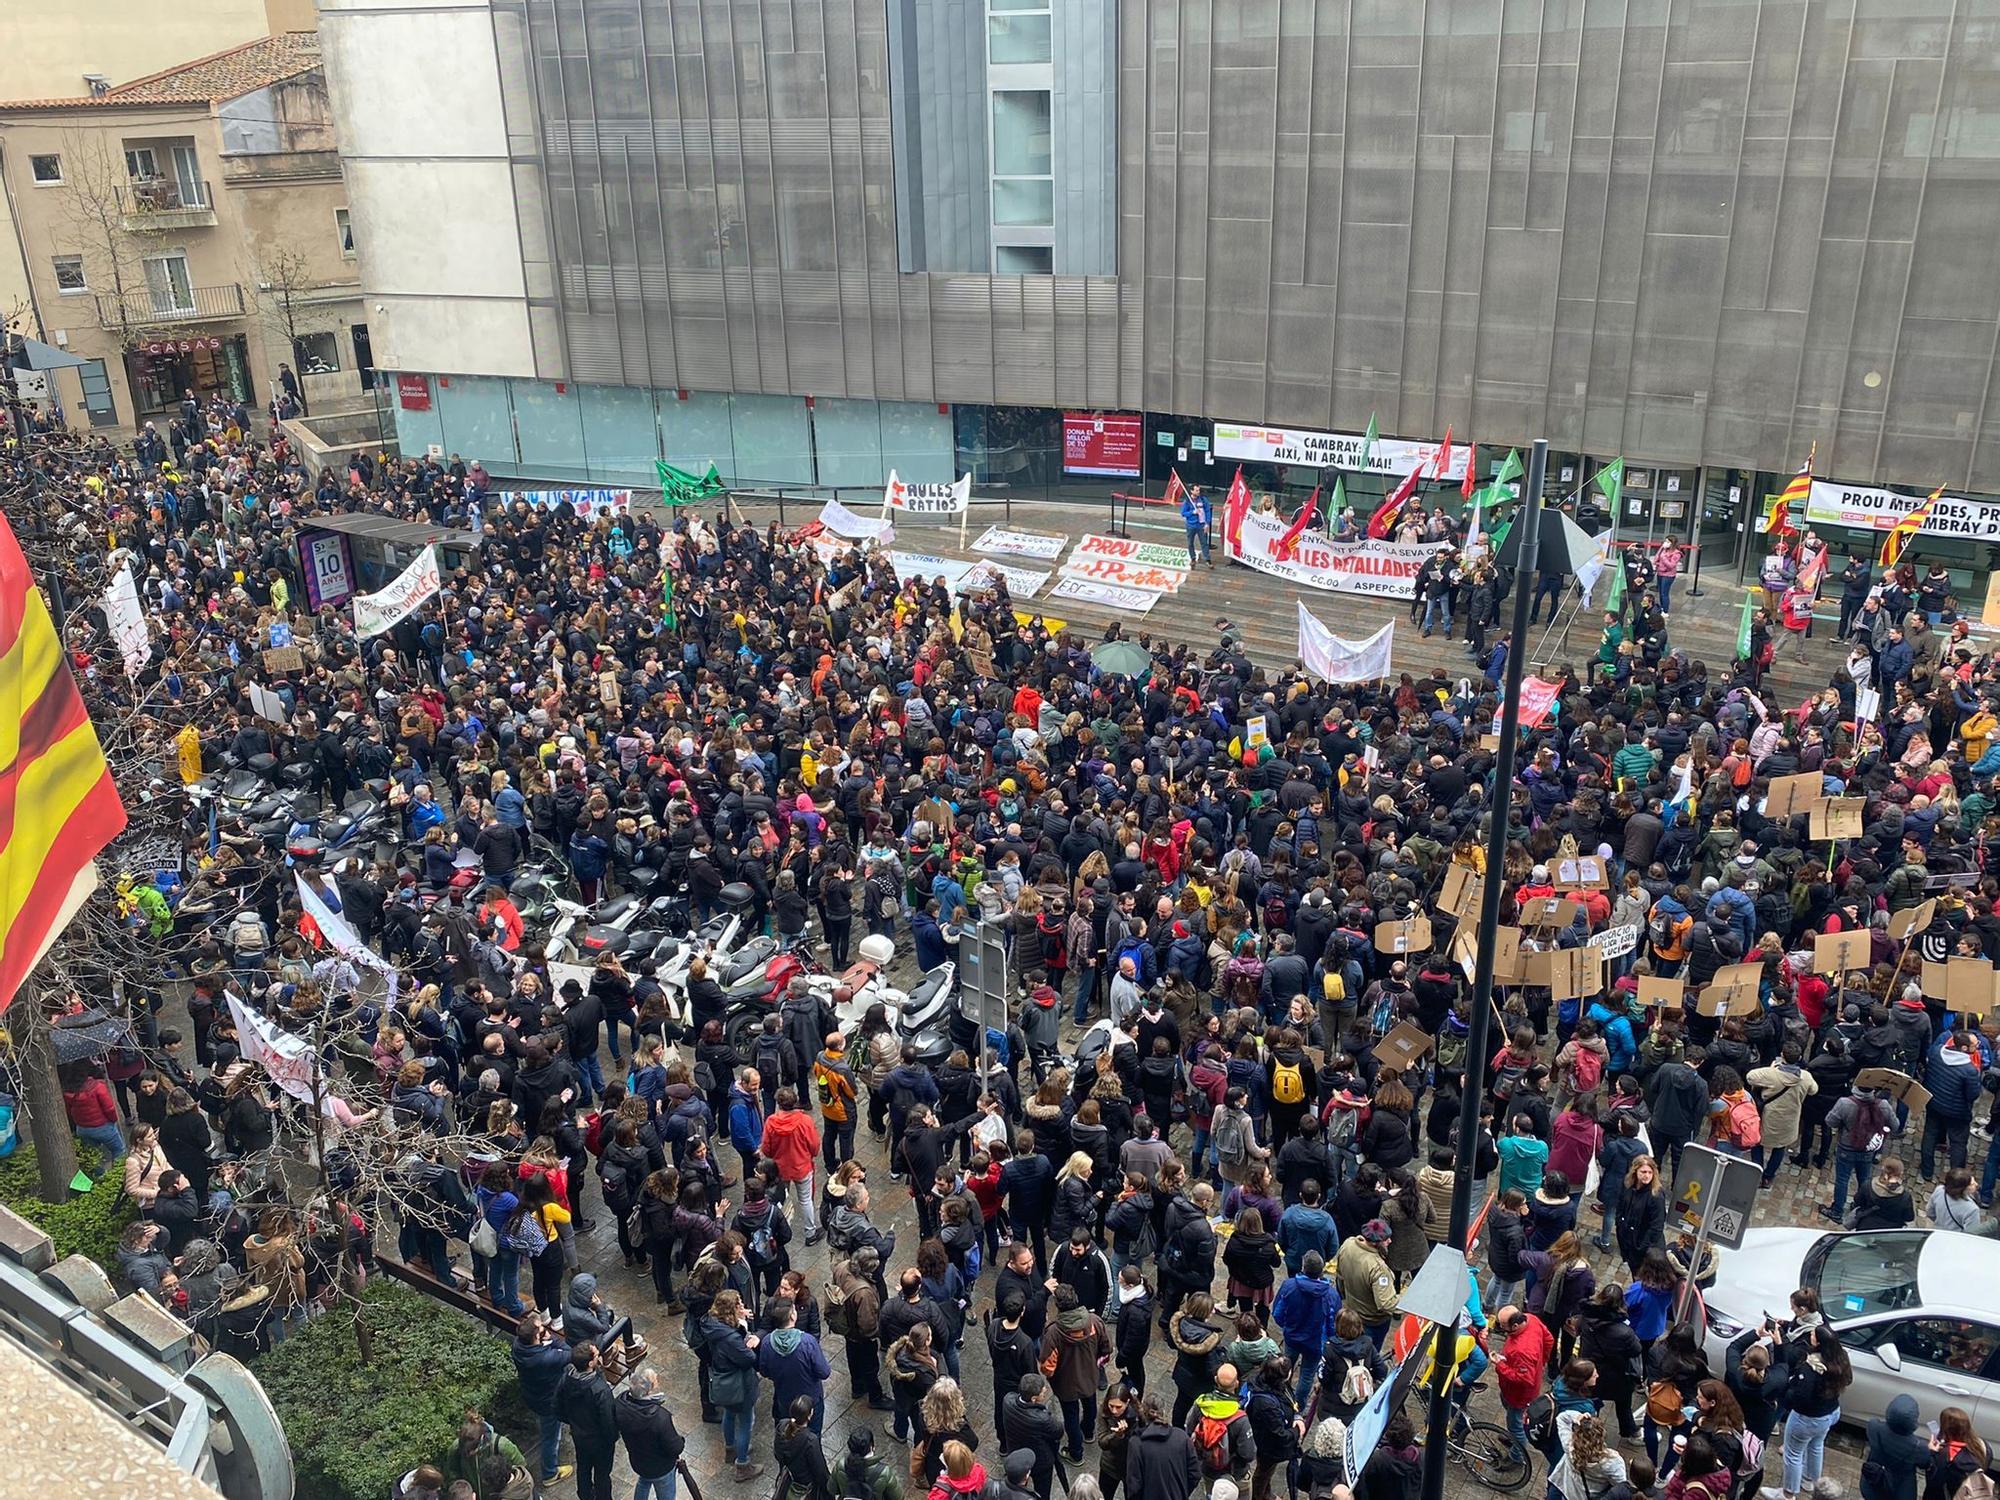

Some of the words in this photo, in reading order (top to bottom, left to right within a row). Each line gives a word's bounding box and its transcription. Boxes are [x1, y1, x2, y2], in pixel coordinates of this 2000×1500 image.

[150, 338, 220, 354] CASAS
[1303, 437, 1362, 453] CAMBRAY:
[1305, 450, 1317, 462] NI
[1321, 452, 1344, 465] ARA
[1348, 455, 1360, 467] NI
[1366, 457, 1392, 470] MAI!
[907, 483, 953, 498] AULES
[1841, 492, 1884, 509] PROU
[1889, 497, 1972, 521] MENIDES,
[1081, 537, 1138, 556] PROU
[1399, 547, 1424, 557] SEVA
[319, 554, 340, 577] 10
[1305, 549, 1330, 569] LES
[321, 573, 345, 586] ANYS
